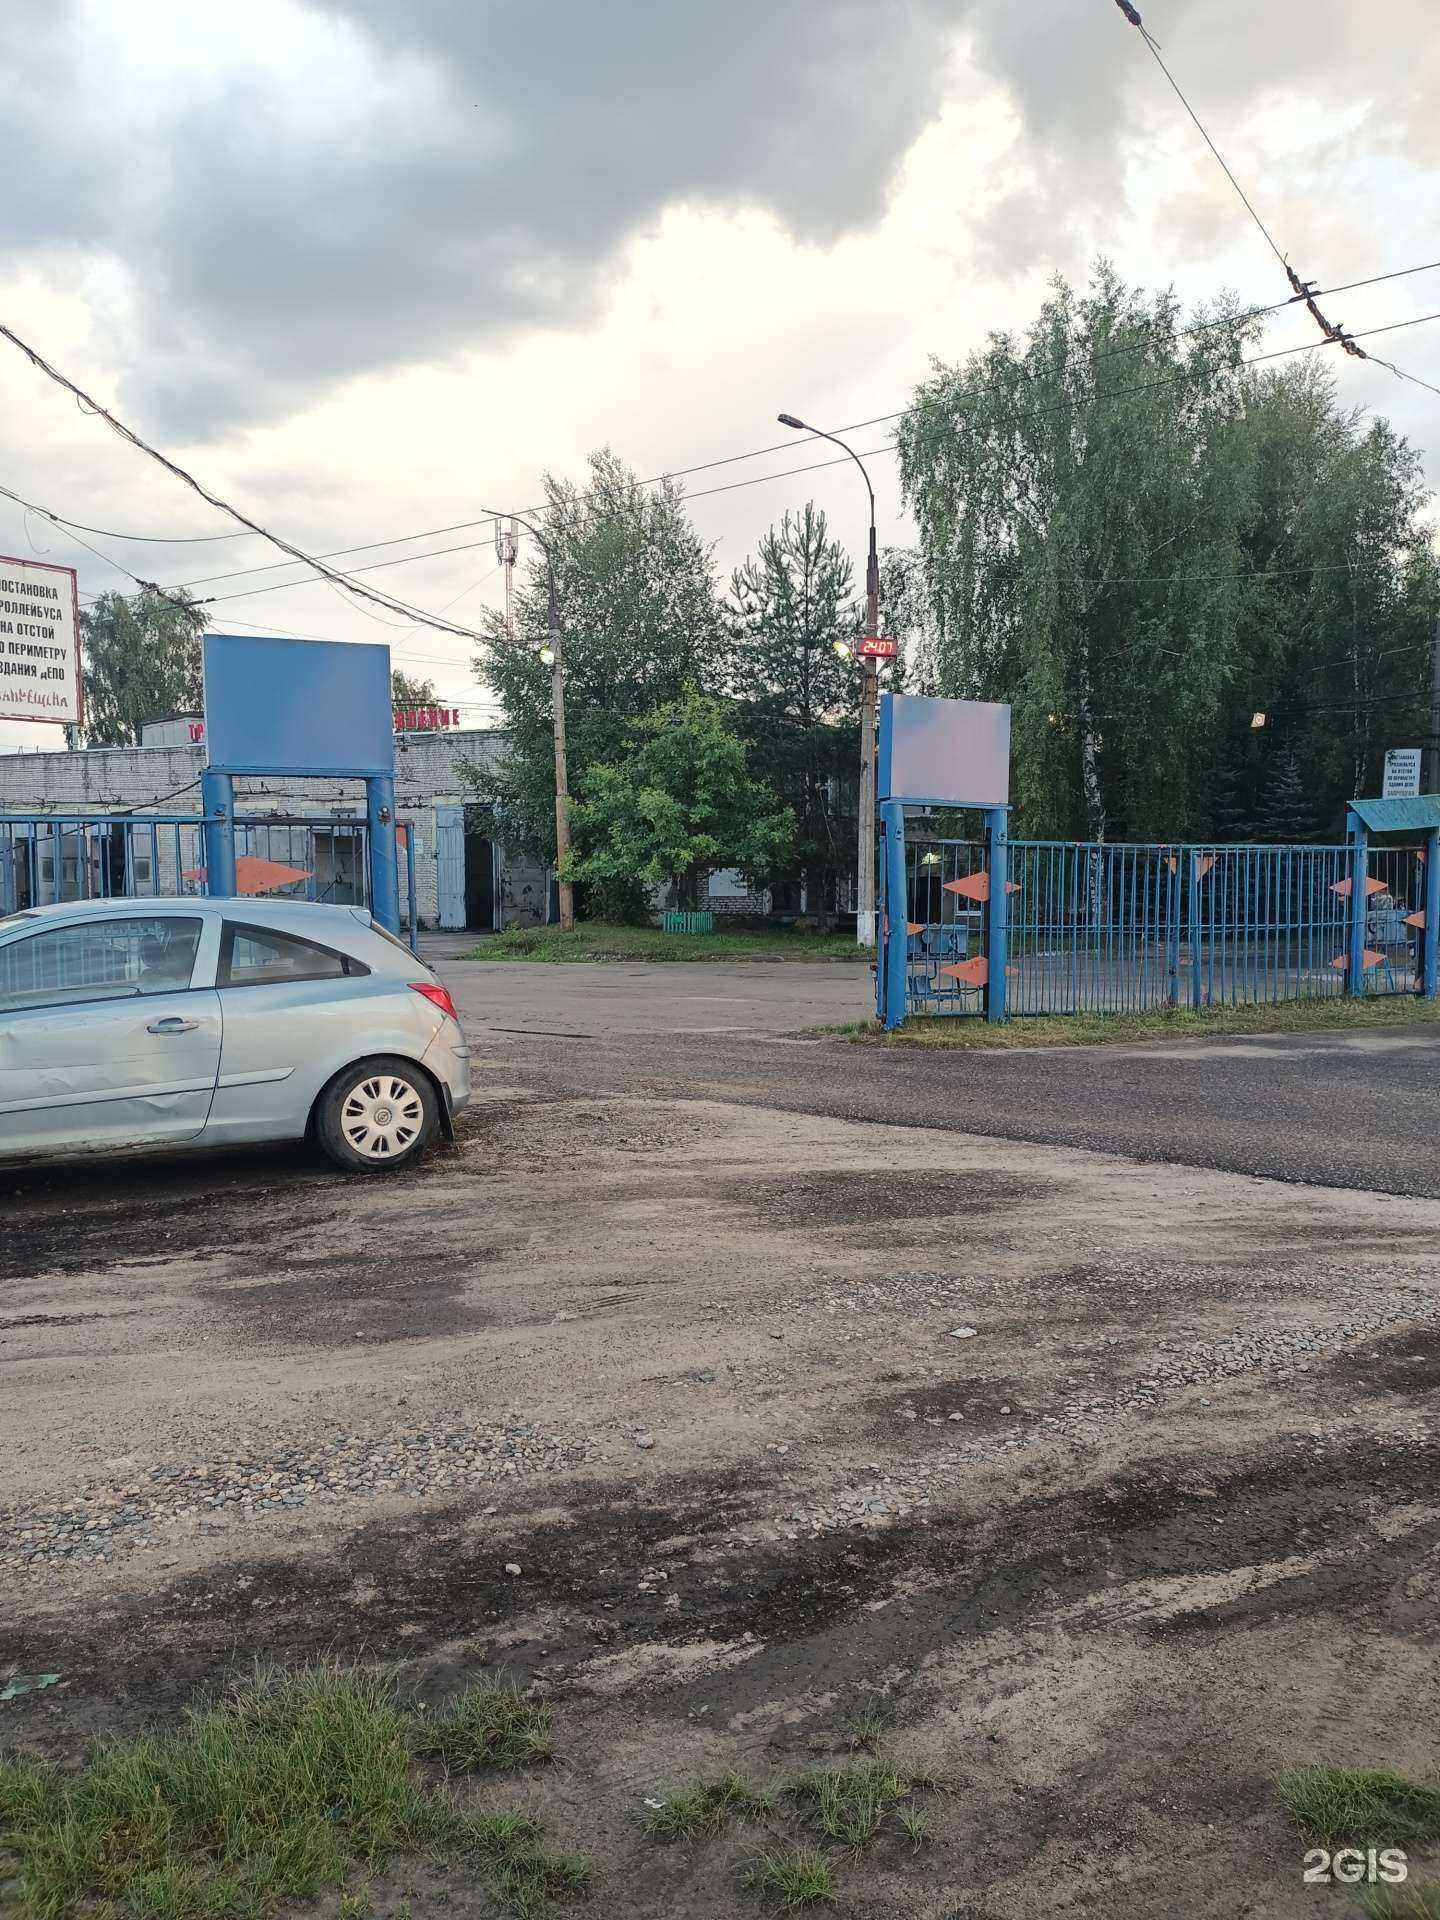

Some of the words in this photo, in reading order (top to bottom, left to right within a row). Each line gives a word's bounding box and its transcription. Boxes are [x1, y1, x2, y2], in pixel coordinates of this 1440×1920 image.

[0, 579, 58, 600] ОСТАНОВКА
[0, 620, 13, 634] НА
[17, 622, 54, 639] ОТСТОЙ
[8, 642, 66, 660] ПЕРИМЕТРУ
